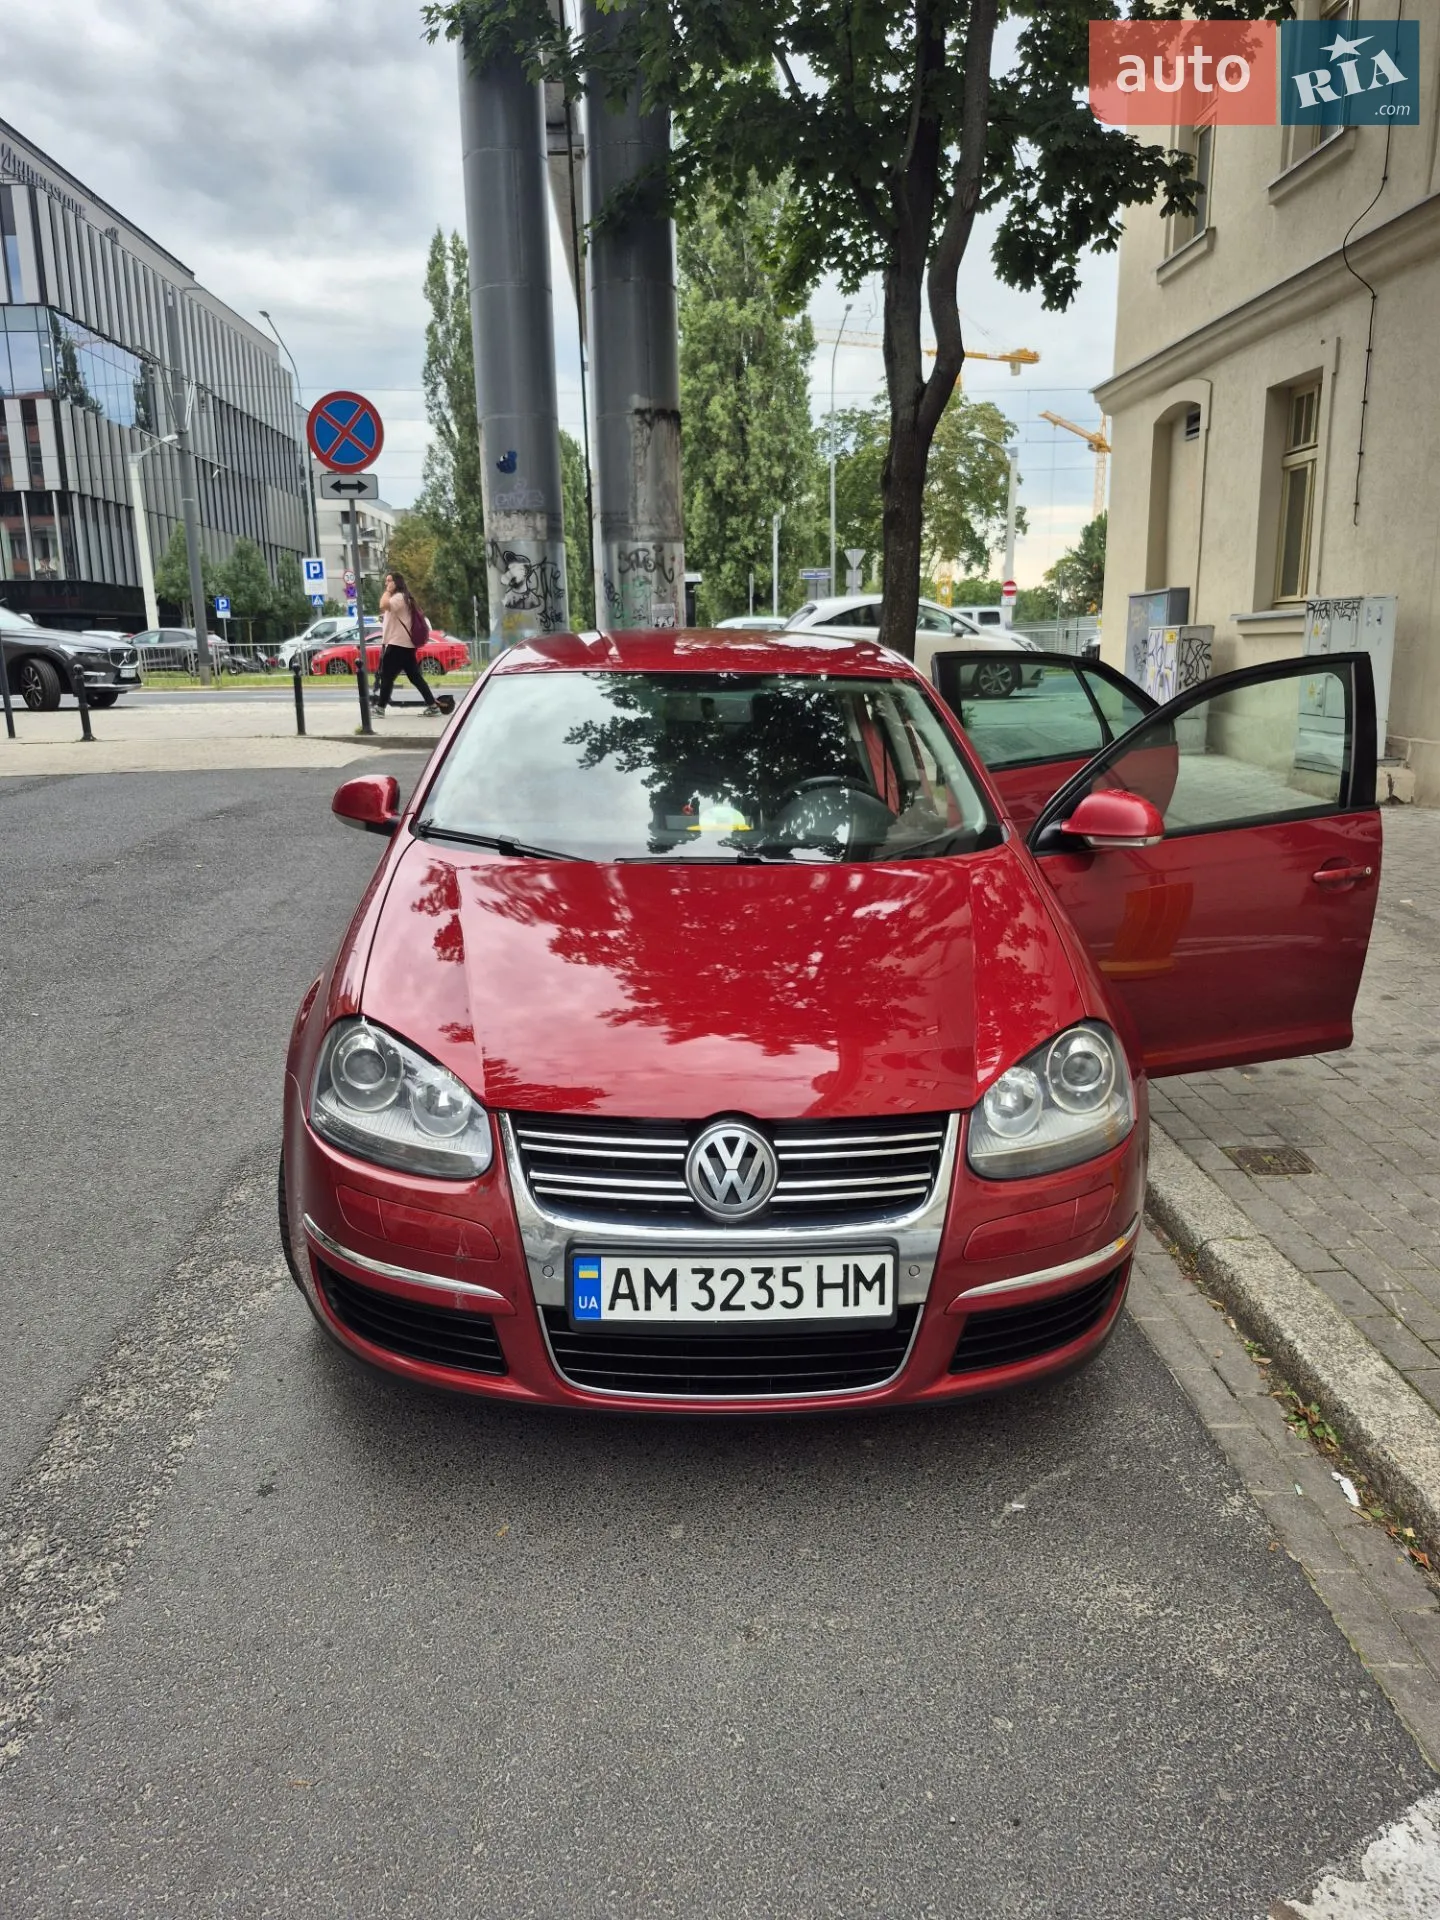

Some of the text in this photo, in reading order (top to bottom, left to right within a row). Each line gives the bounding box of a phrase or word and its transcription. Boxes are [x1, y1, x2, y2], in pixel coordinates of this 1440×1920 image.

[578, 1296, 598, 1309] UA
[608, 1263, 886, 1312] AM 3235 HM
